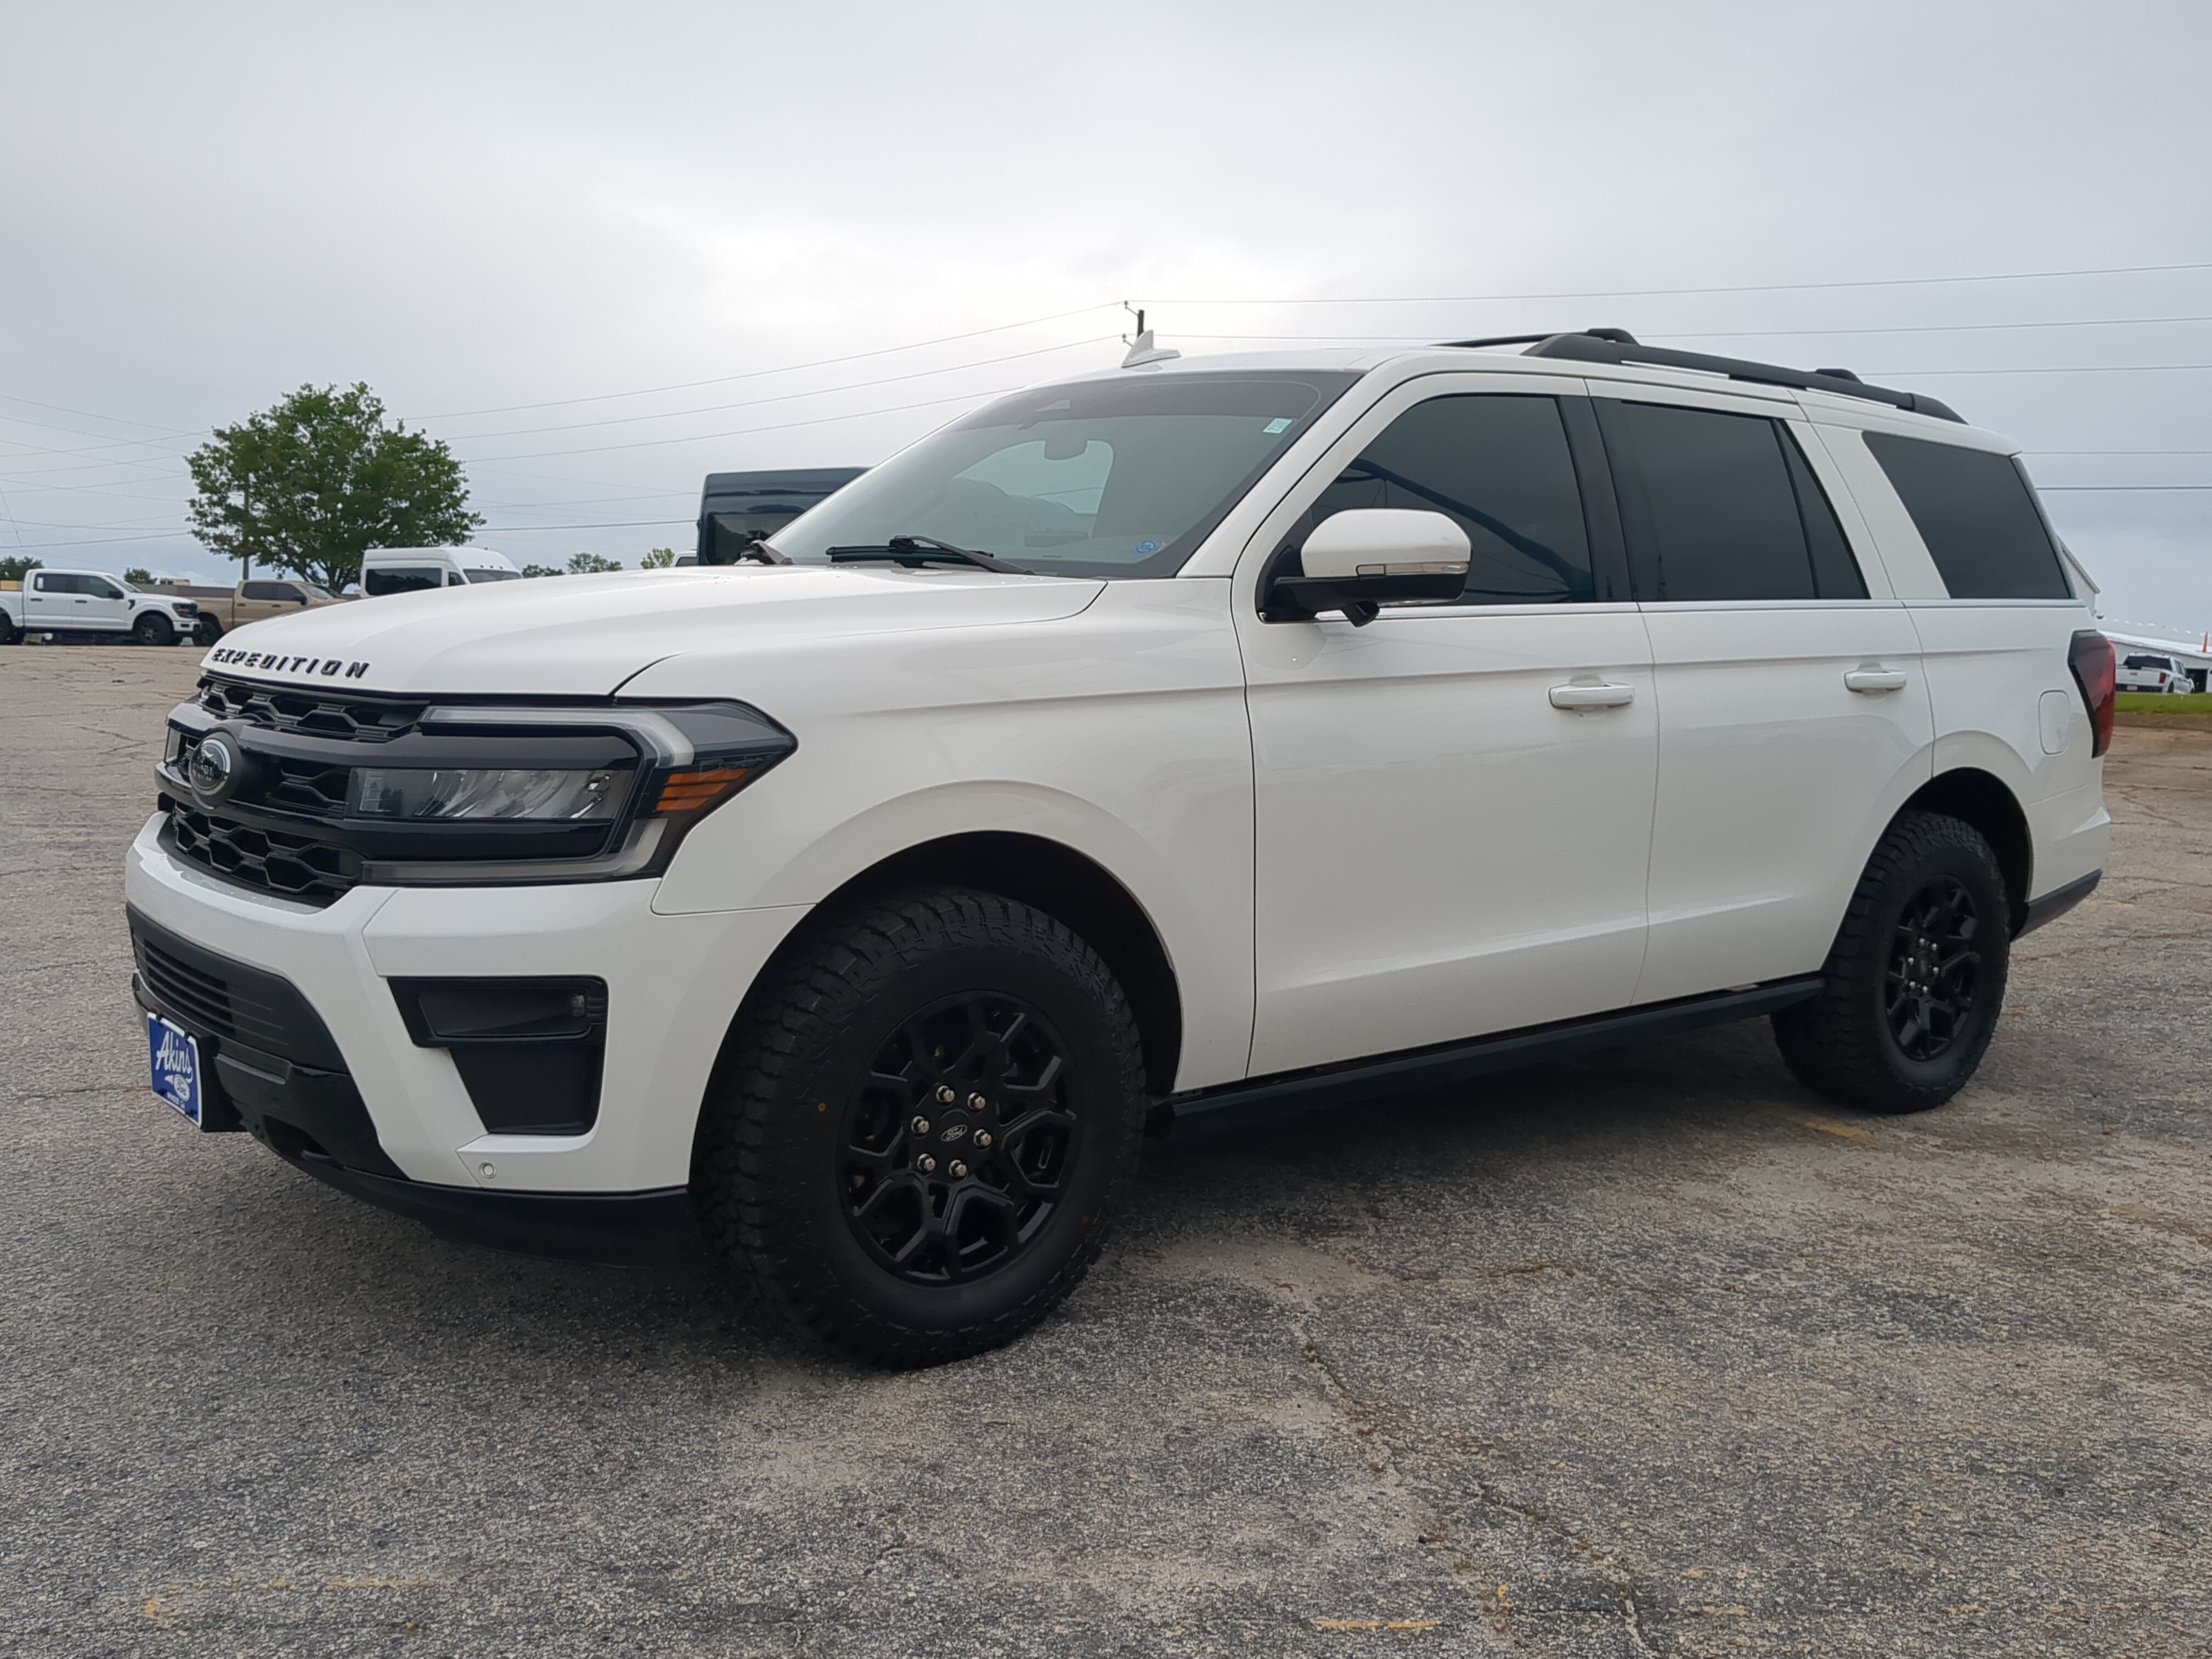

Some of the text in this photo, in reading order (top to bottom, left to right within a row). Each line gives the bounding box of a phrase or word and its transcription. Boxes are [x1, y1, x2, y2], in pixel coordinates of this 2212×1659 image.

[212, 648, 370, 679] EXPEDITION
[155, 1030, 193, 1076] Akins
[945, 1126, 964, 1140] Ford
